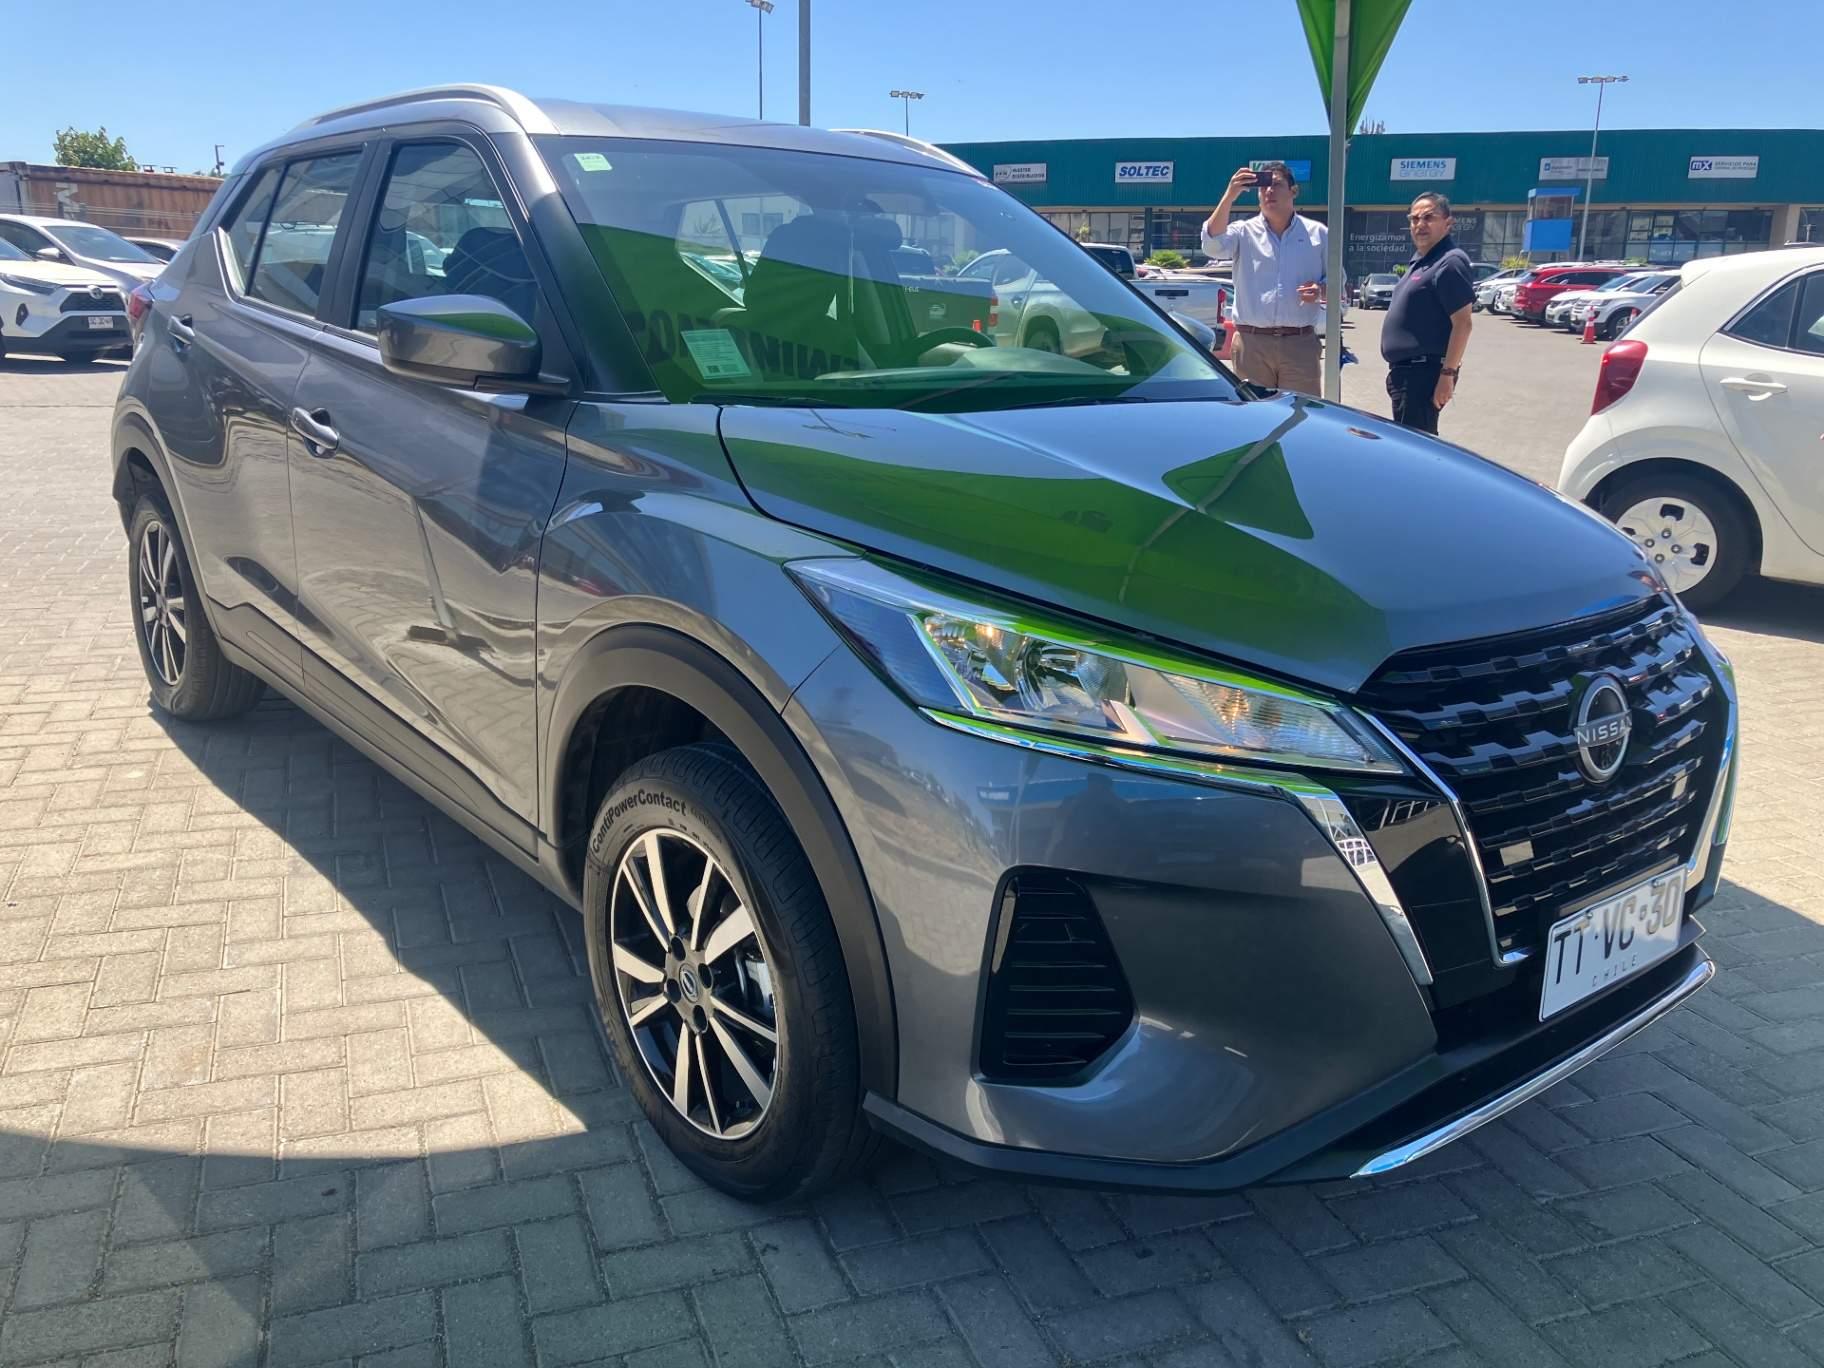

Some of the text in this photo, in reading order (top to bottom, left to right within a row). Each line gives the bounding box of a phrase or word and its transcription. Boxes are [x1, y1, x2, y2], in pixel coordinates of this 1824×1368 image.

[1119, 165, 1170, 177] SOLTEC
[1400, 160, 1447, 169] SIEMENS
[1577, 716, 1632, 745] NISSAN
[592, 788, 687, 853] ContiPowerContact
[1591, 954, 1637, 987] CHILE
